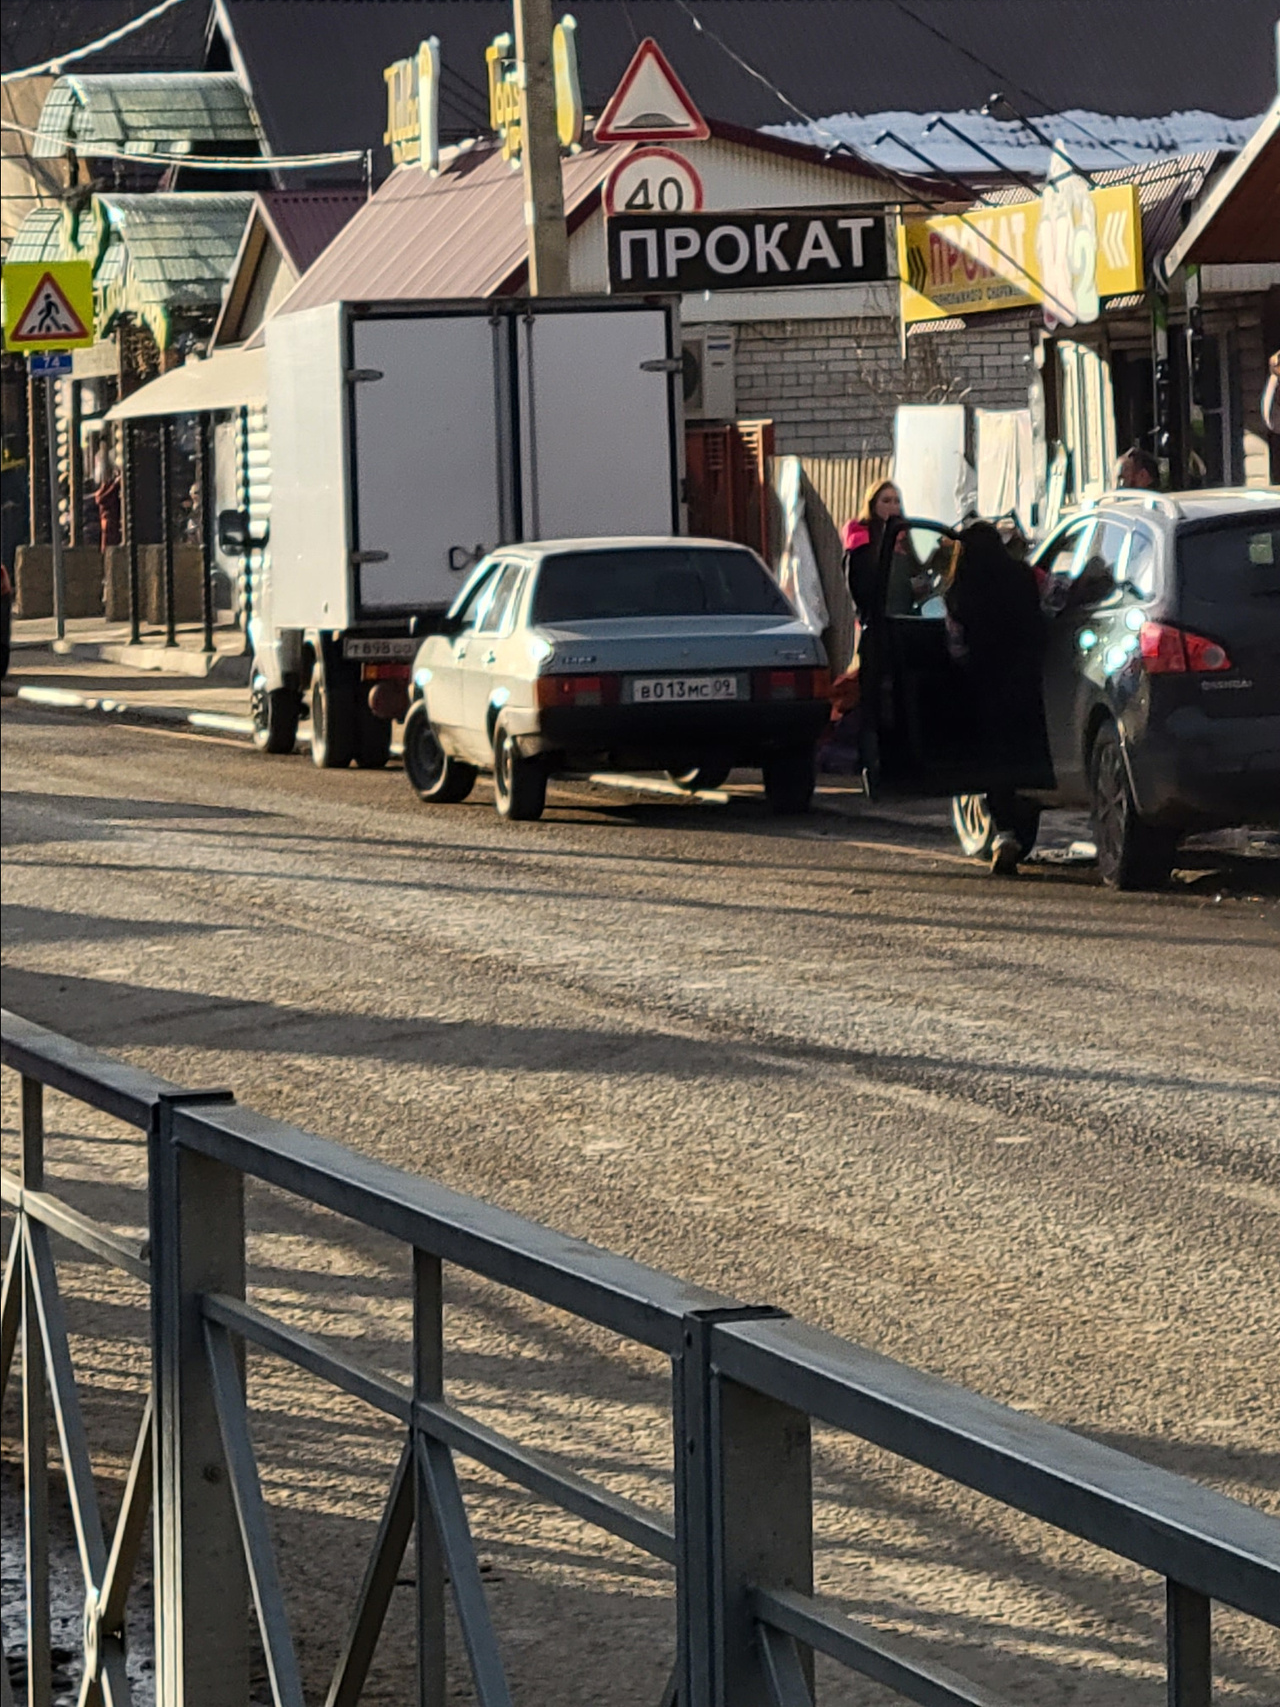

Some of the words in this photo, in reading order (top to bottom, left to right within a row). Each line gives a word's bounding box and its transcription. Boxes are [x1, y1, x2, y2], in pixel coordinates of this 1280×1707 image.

[625, 176, 684, 210] 40
[619, 218, 875, 280] ПРОКАТ
[641, 680, 709, 699] В013МС
